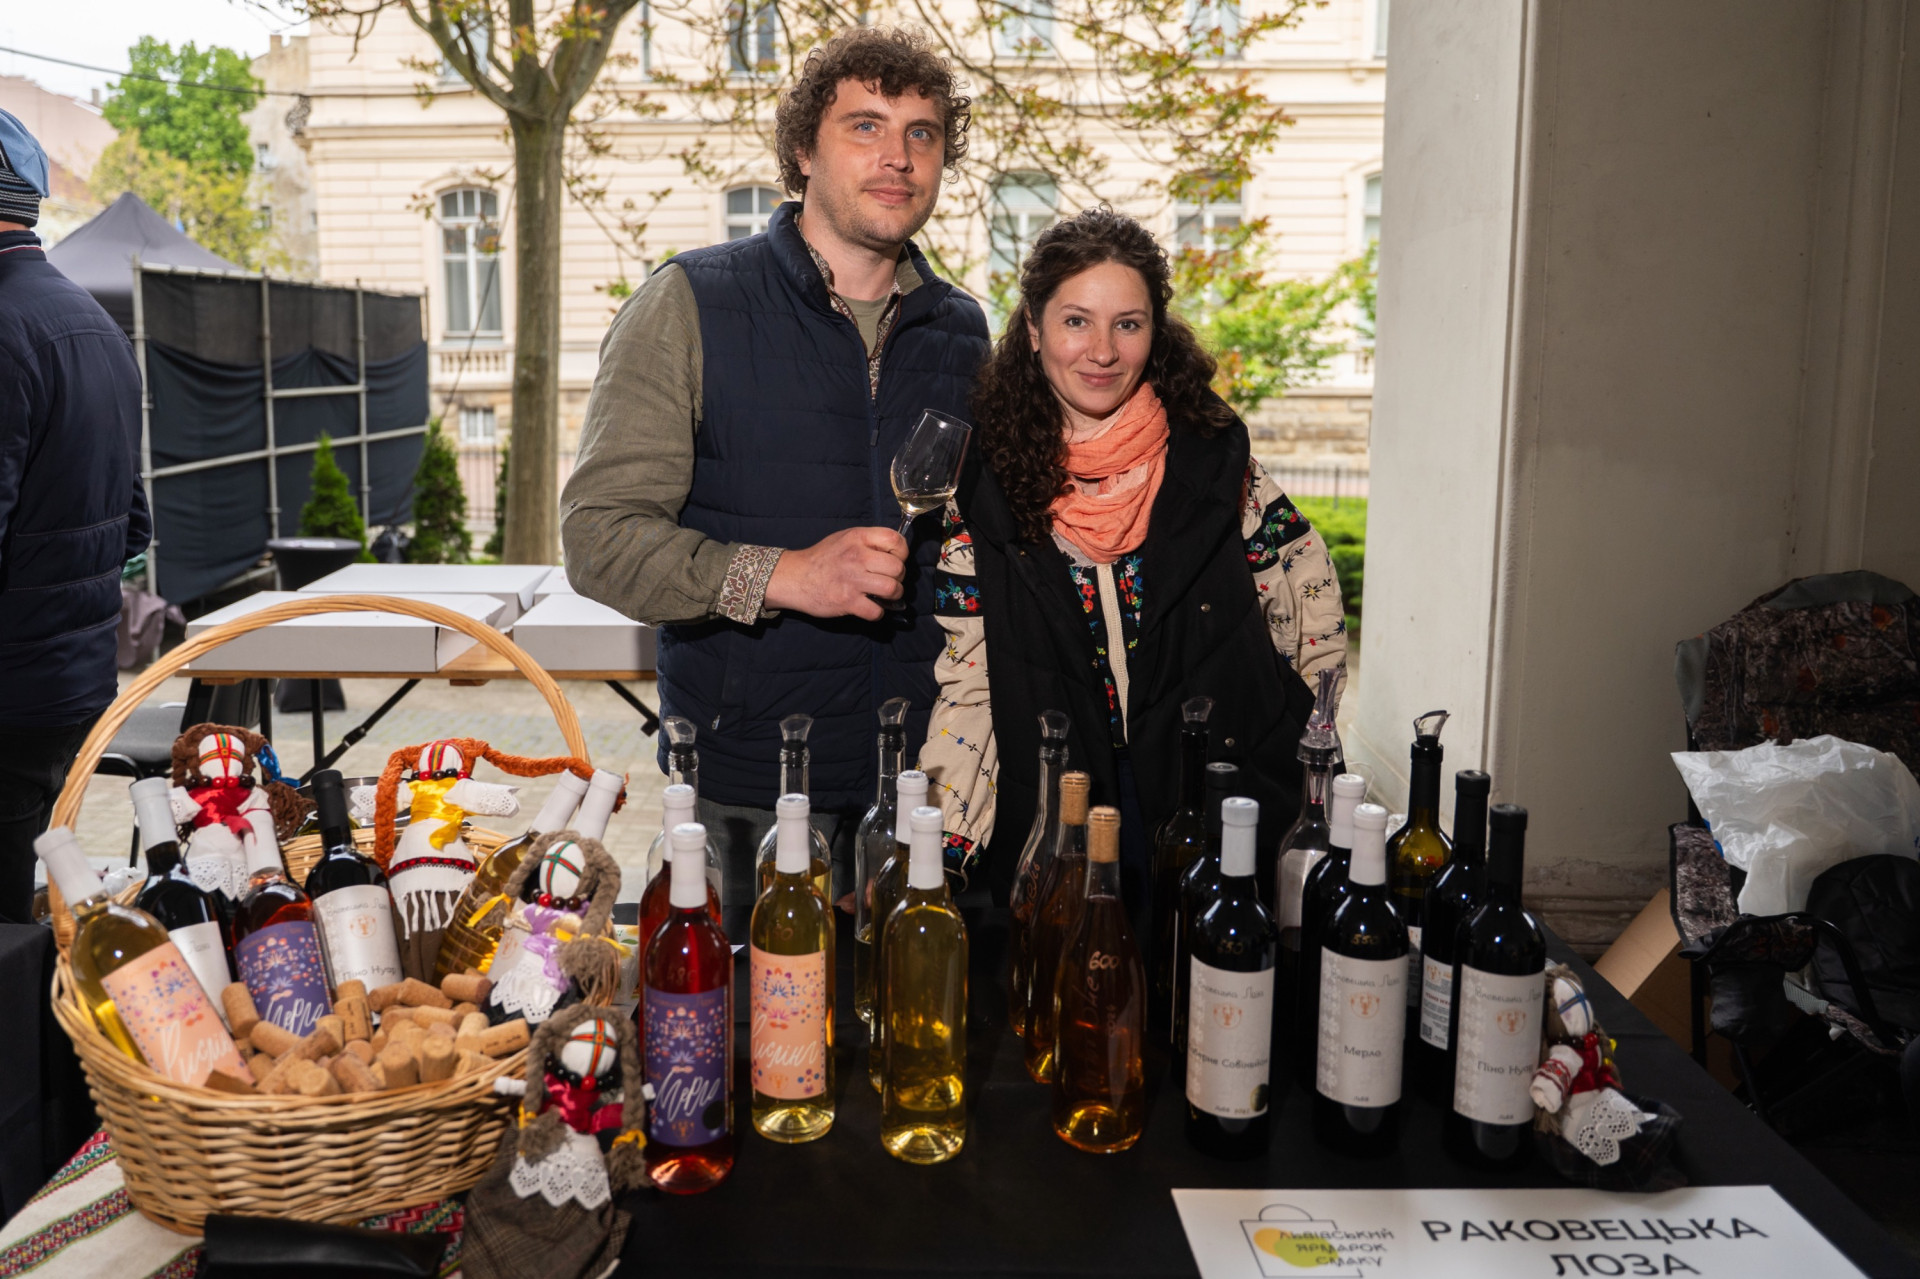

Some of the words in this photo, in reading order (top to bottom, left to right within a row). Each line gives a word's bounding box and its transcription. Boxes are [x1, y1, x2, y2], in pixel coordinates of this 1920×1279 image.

[1089, 951, 1120, 970] 600
[1344, 1045, 1382, 1058] Мерло
[1478, 1060, 1505, 1074] Піно
[1279, 1227, 1395, 1240] ЛЬВІВСЬКИЙ
[1421, 1217, 1769, 1245] РАКОВЕЦЬКА
[1297, 1242, 1387, 1253] ЯРМАРОК
[1315, 1255, 1383, 1268] СМАКУ
[1549, 1252, 1702, 1276] ЛОЗА
